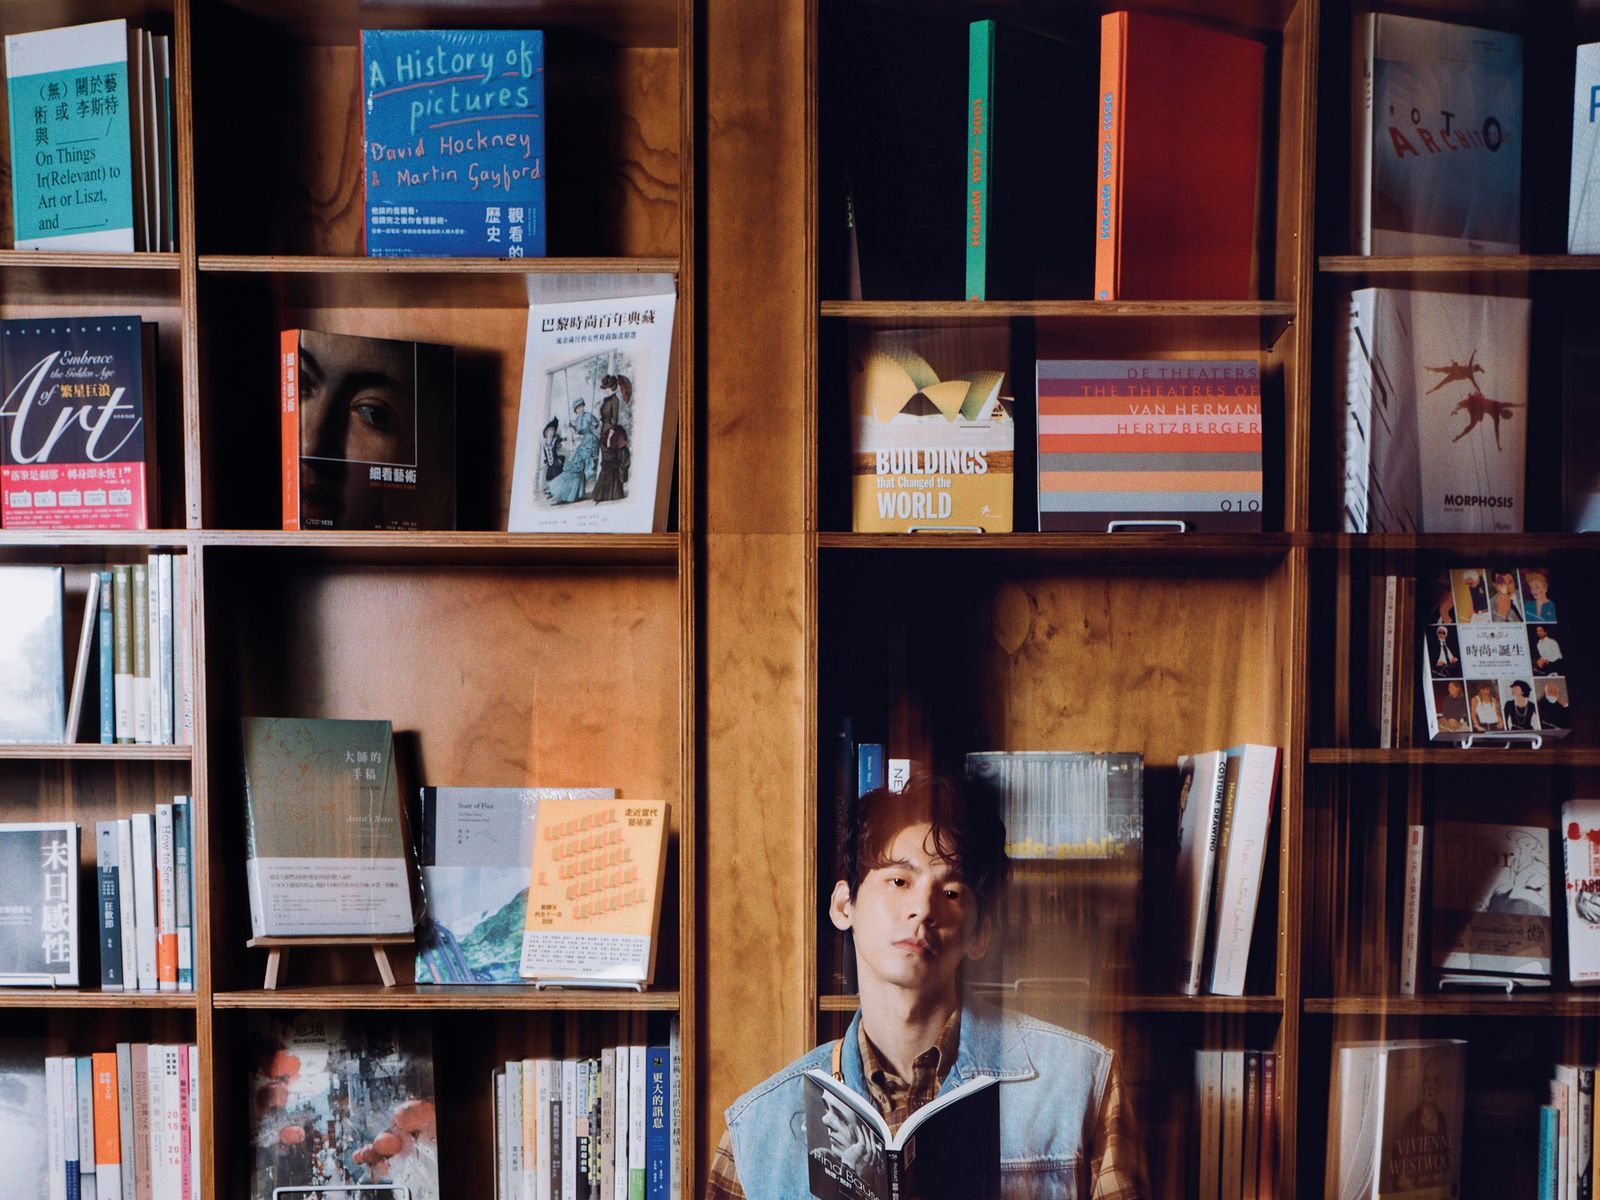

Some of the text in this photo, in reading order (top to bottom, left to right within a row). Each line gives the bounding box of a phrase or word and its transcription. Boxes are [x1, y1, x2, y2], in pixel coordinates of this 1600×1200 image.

[371, 40, 533, 88] A History of
[410, 86, 529, 135] pictures
[371, 130, 532, 161] David Hockney
[35, 147, 96, 167] On Things
[109, 166, 121, 179] to
[396, 165, 458, 187] Martin
[468, 158, 541, 192] Gayford
[38, 193, 57, 210] Art
[61, 192, 72, 206] or
[38, 214, 60, 232] and
[485, 207, 500, 243] 歷史
[508, 207, 524, 257] 觀看的
[541, 309, 656, 333] 巴黎時尚百年典藏
[60, 350, 114, 367] Embrace
[50, 367, 63, 379] the
[64, 365, 94, 379] Golden
[1127, 367, 1257, 379] DE THEATERS
[38, 384, 58, 406] of
[1081, 385, 1260, 398] THE THEATRES OF
[0, 351, 142, 464] Art
[1129, 404, 1258, 415] VAN HERMAN
[1117, 423, 1260, 435] HERTZBERGER
[875, 449, 988, 475] BUILDINGS
[369, 466, 417, 483] 細看藝術
[877, 476, 951, 489] that Changed the
[877, 491, 952, 519] WORLD
[1444, 494, 1513, 508] MORPHOSIS
[344, 750, 382, 764] 大師的
[353, 767, 376, 781] 手稿
[1210, 761, 1226, 852] COSTUME DRAWING
[161, 825, 173, 885] How to See
[41, 840, 70, 965] 末日感性
[652, 1072, 664, 1129] 更大的訊息
